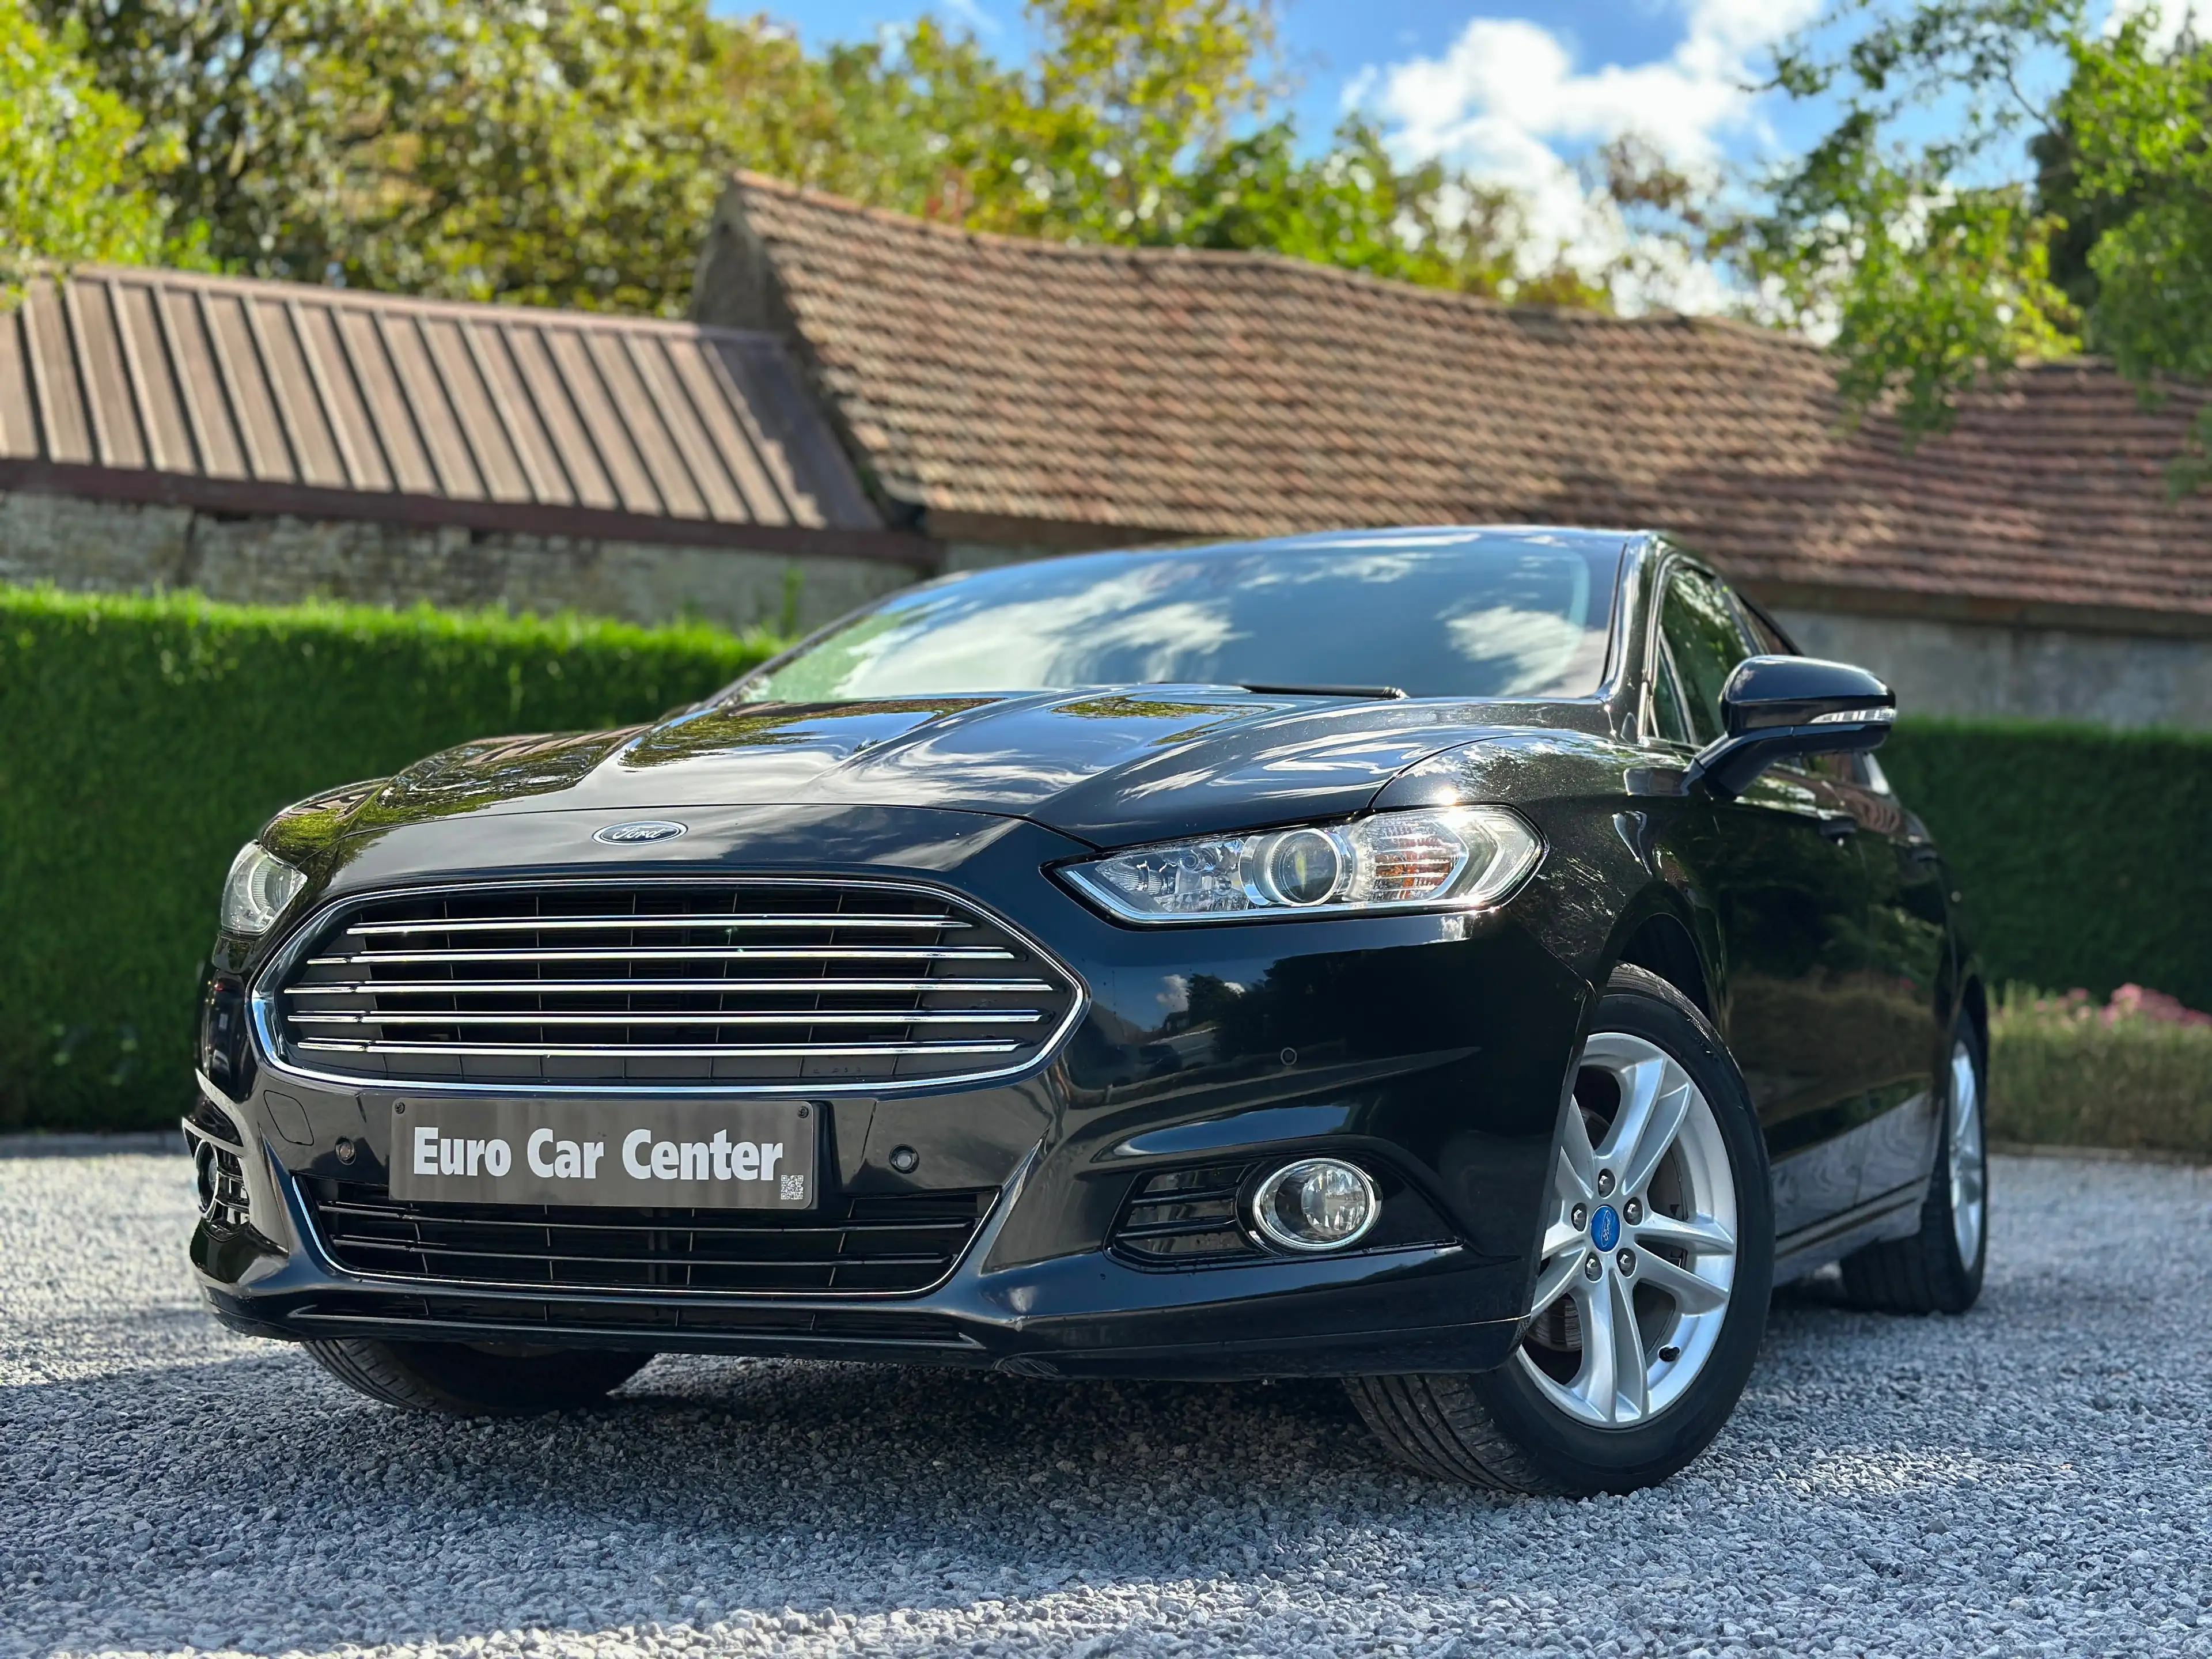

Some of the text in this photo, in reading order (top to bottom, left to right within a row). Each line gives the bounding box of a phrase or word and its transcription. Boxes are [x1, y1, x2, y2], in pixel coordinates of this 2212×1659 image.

[612, 824, 665, 840] Ford
[414, 1127, 783, 1181] Euro Car Center
